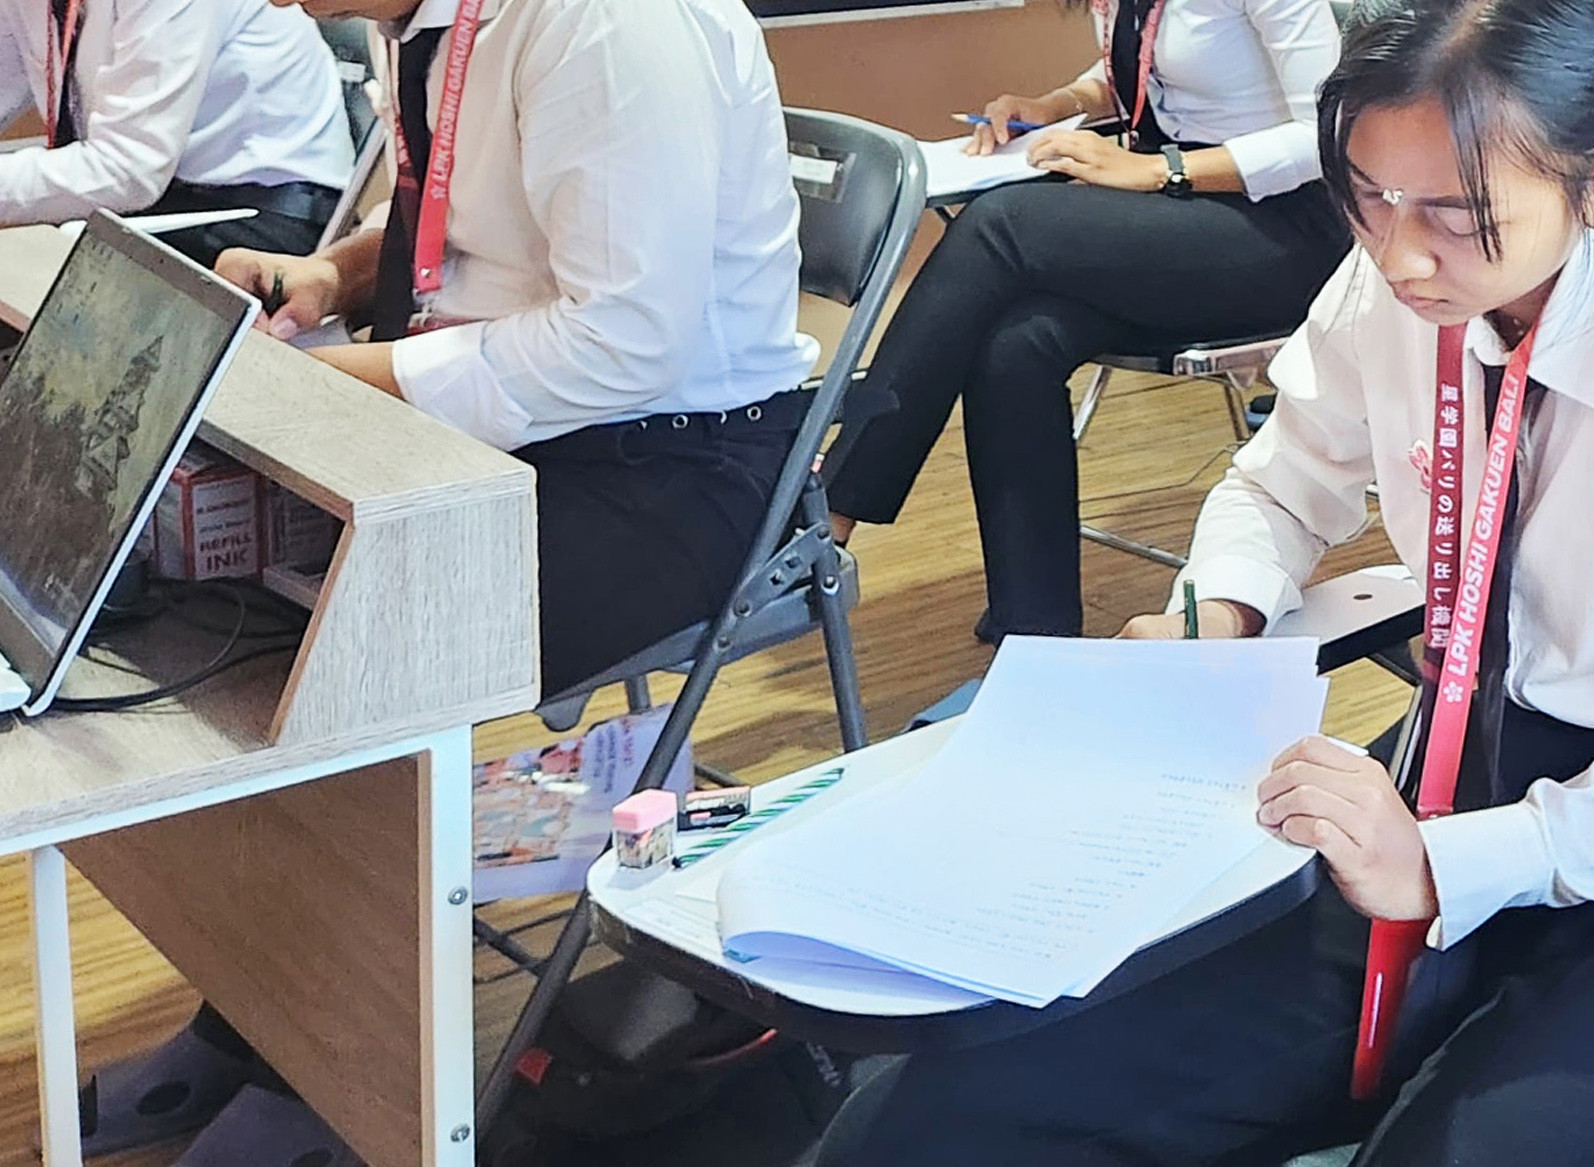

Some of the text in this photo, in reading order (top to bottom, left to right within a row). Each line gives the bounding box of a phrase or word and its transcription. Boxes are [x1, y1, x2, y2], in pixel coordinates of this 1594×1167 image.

[1446, 374, 1520, 677] LPK HOSHI GAKUEN BALI
[200, 533, 252, 552] REFILL
[207, 549, 247, 570] INK
